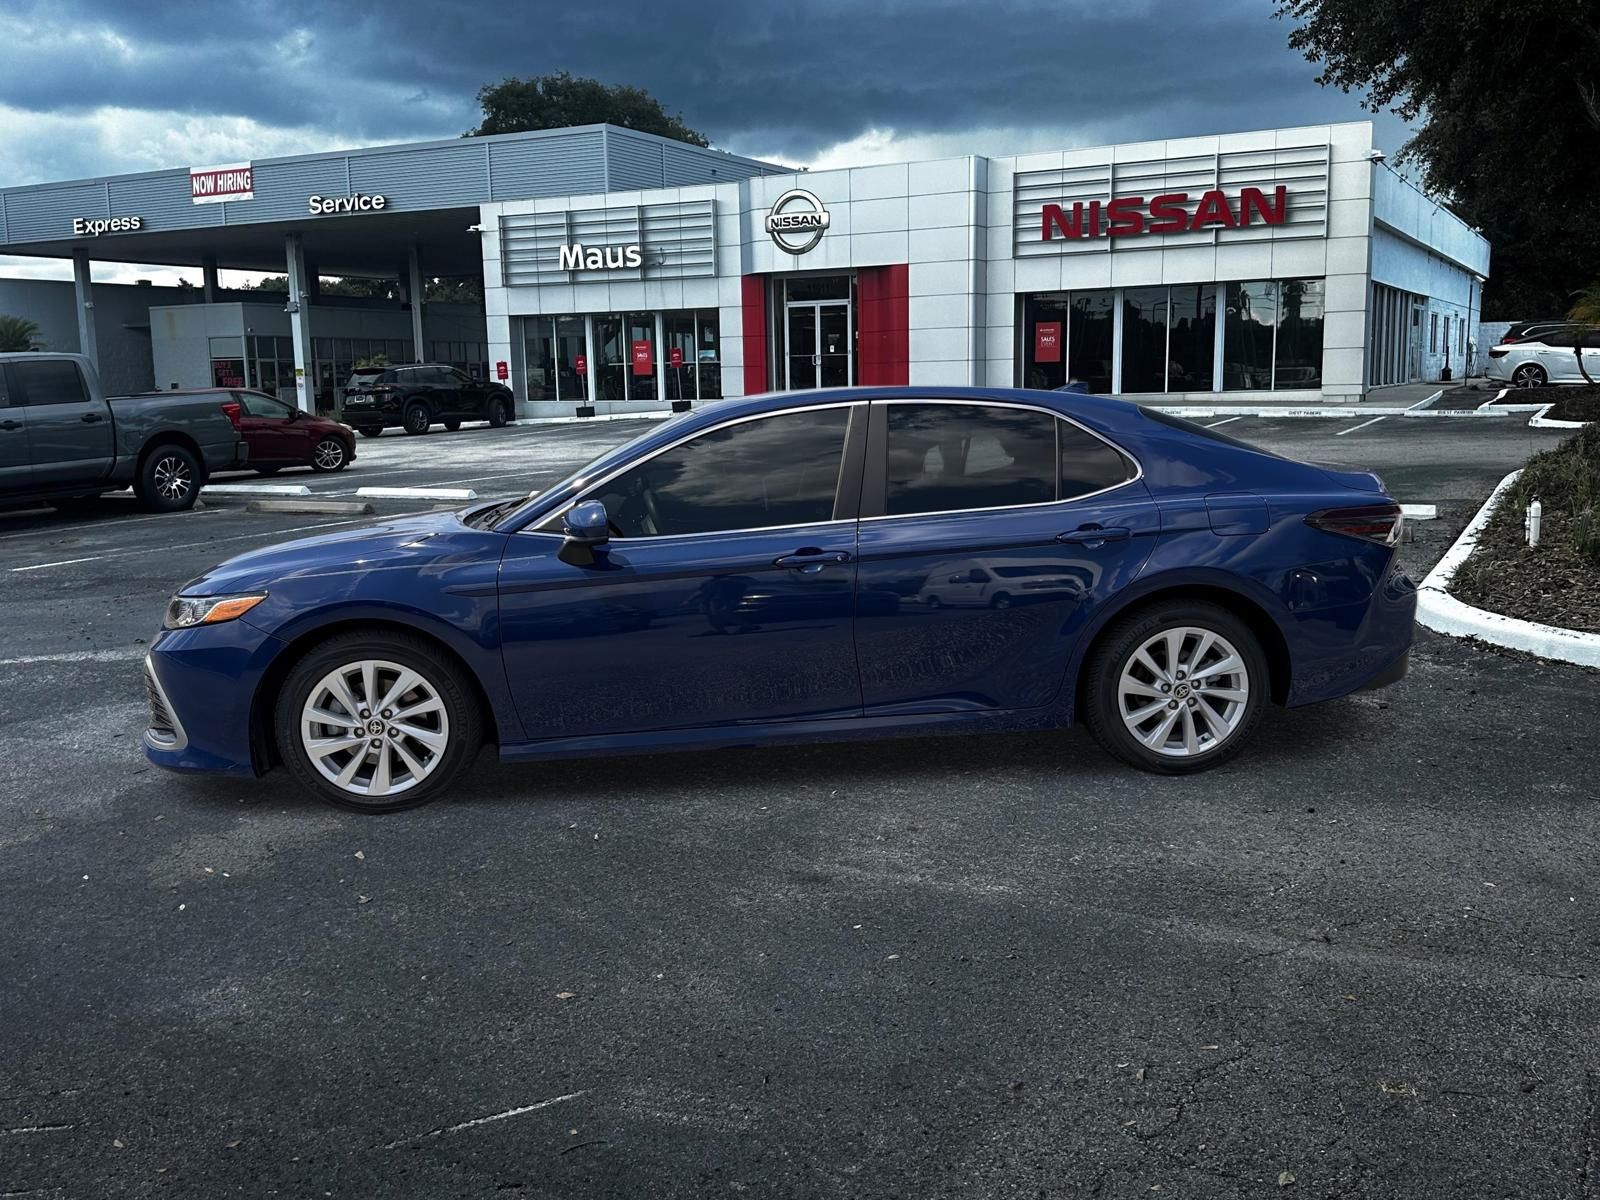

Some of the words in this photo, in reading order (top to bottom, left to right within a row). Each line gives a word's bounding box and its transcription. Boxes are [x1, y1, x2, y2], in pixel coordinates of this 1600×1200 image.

[193, 175, 215, 195] NOW
[217, 171, 251, 192] HIRING
[309, 193, 385, 215] Service
[1042, 185, 1287, 241] NISSAN
[73, 217, 141, 237] Express
[770, 214, 822, 229] NISSAN
[559, 243, 642, 271] Maus
[223, 377, 243, 385] FREE
